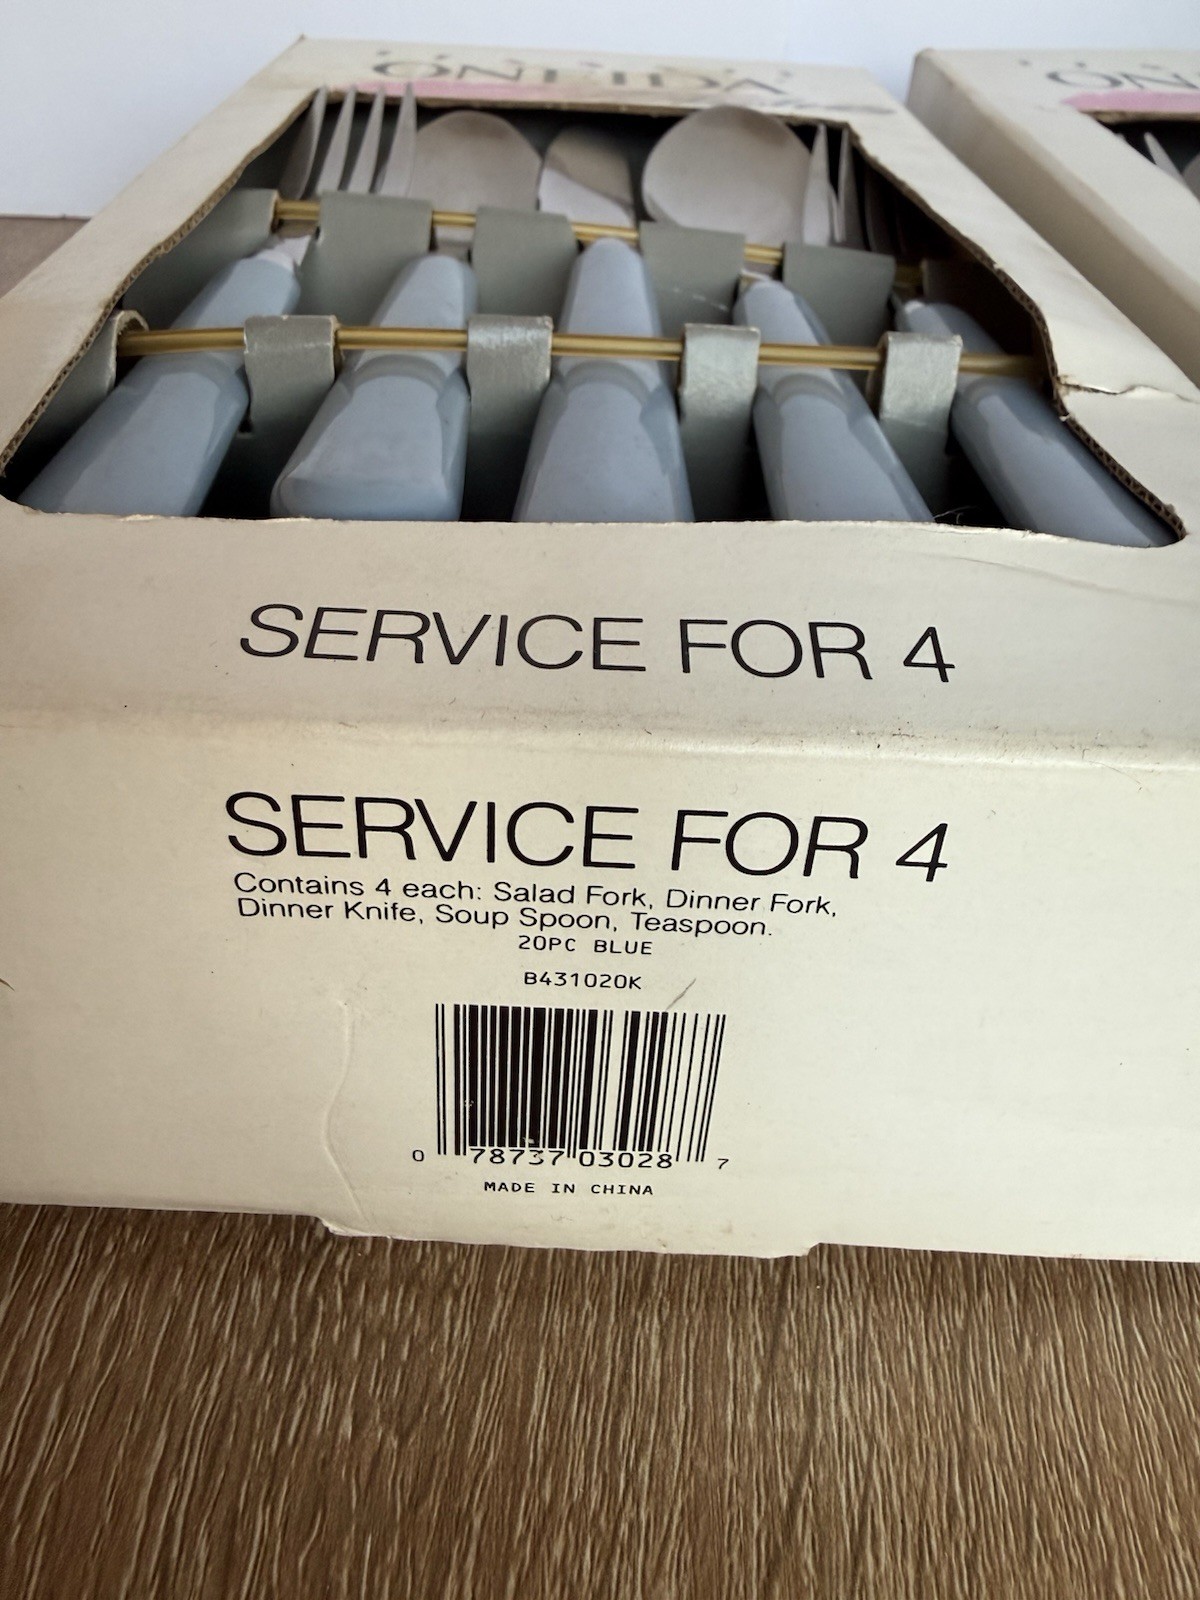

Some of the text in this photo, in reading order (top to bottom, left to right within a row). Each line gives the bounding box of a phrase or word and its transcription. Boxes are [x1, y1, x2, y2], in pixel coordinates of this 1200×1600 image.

[240, 604, 956, 683] SERVICE FOR 4
[226, 791, 948, 882] SERVICE FOR 4
[234, 871, 837, 918] Contains 4 each: Salad Fork, Dinner Fork,
[238, 897, 773, 938] Dinner Knife, Soup Spoon, Teaspoon.
[518, 934, 654, 955] 20PC BLUE
[524, 971, 643, 990] B431020K
[412, 1148, 730, 1171] 0 78737 03028 7
[484, 1181, 654, 1196] MADE IN CHINA
